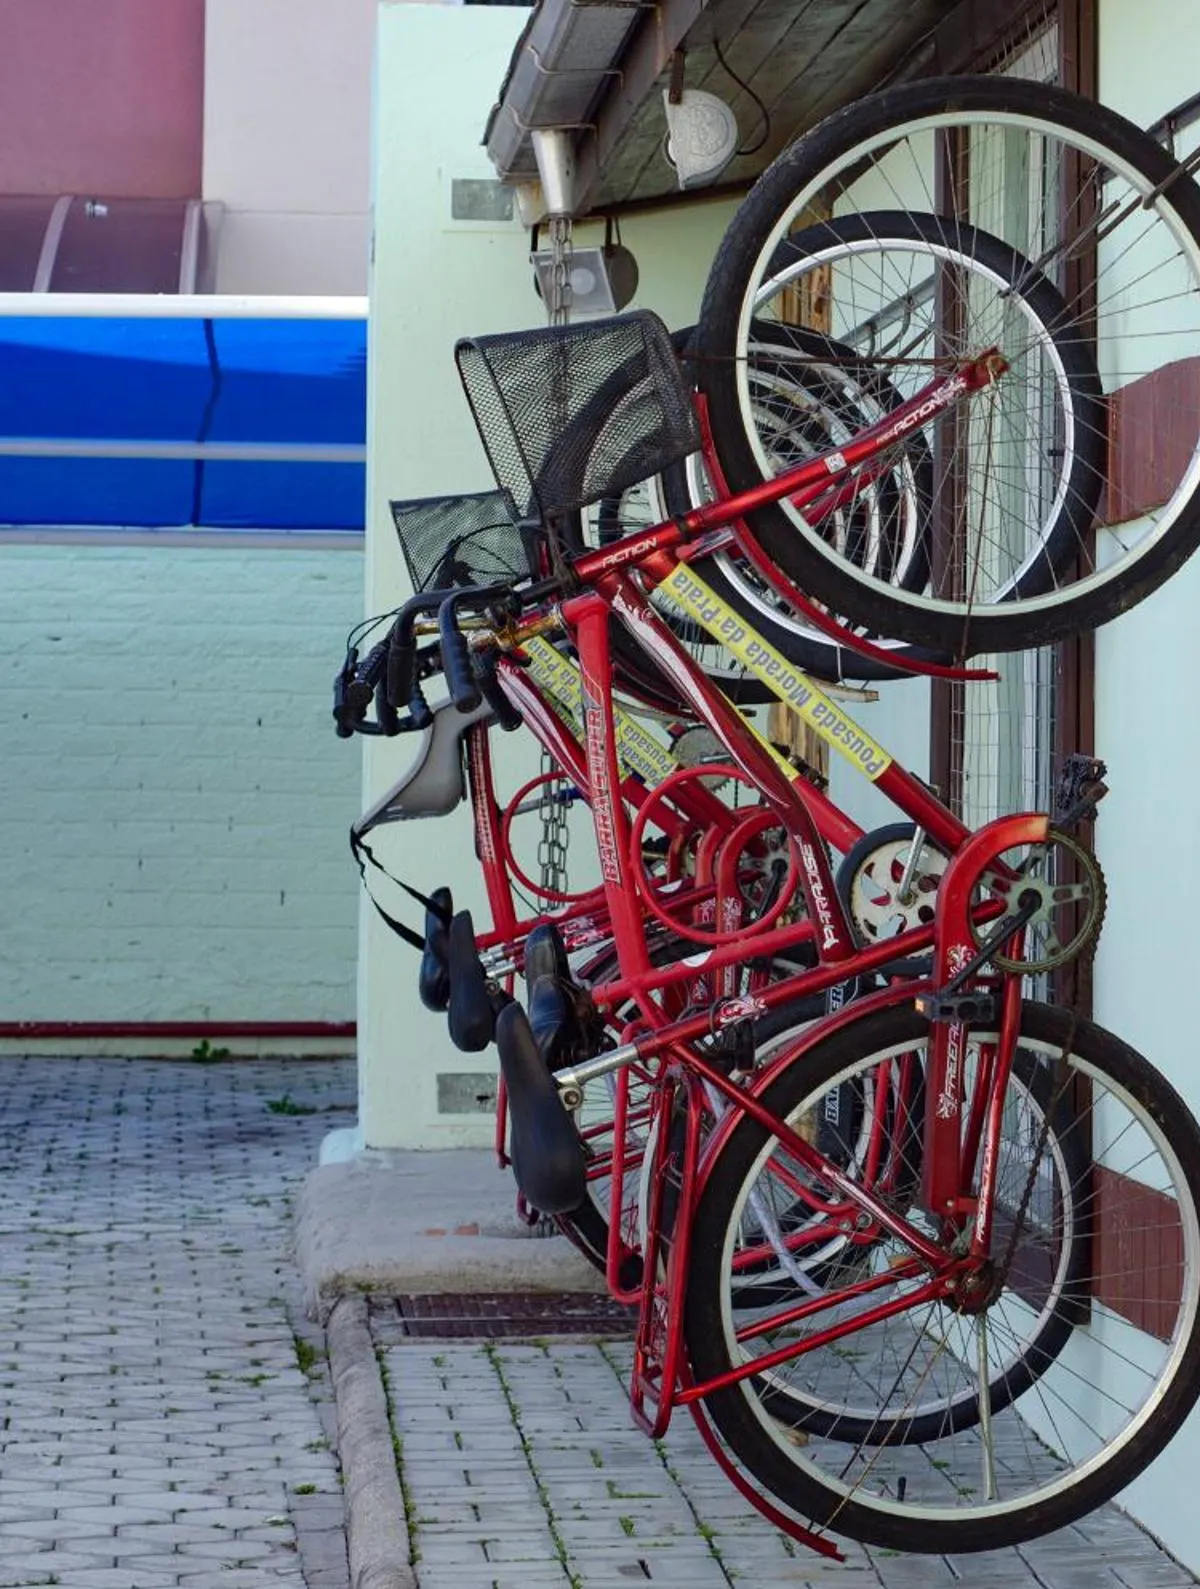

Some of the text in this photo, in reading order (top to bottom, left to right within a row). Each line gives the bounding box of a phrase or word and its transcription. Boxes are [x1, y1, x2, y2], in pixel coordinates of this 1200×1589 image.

[603, 537, 657, 568] ACTION
[672, 571, 885, 774] Pousada Morada da Praia
[623, 725, 672, 772] Pousada
[799, 840, 839, 950] PARADISE
